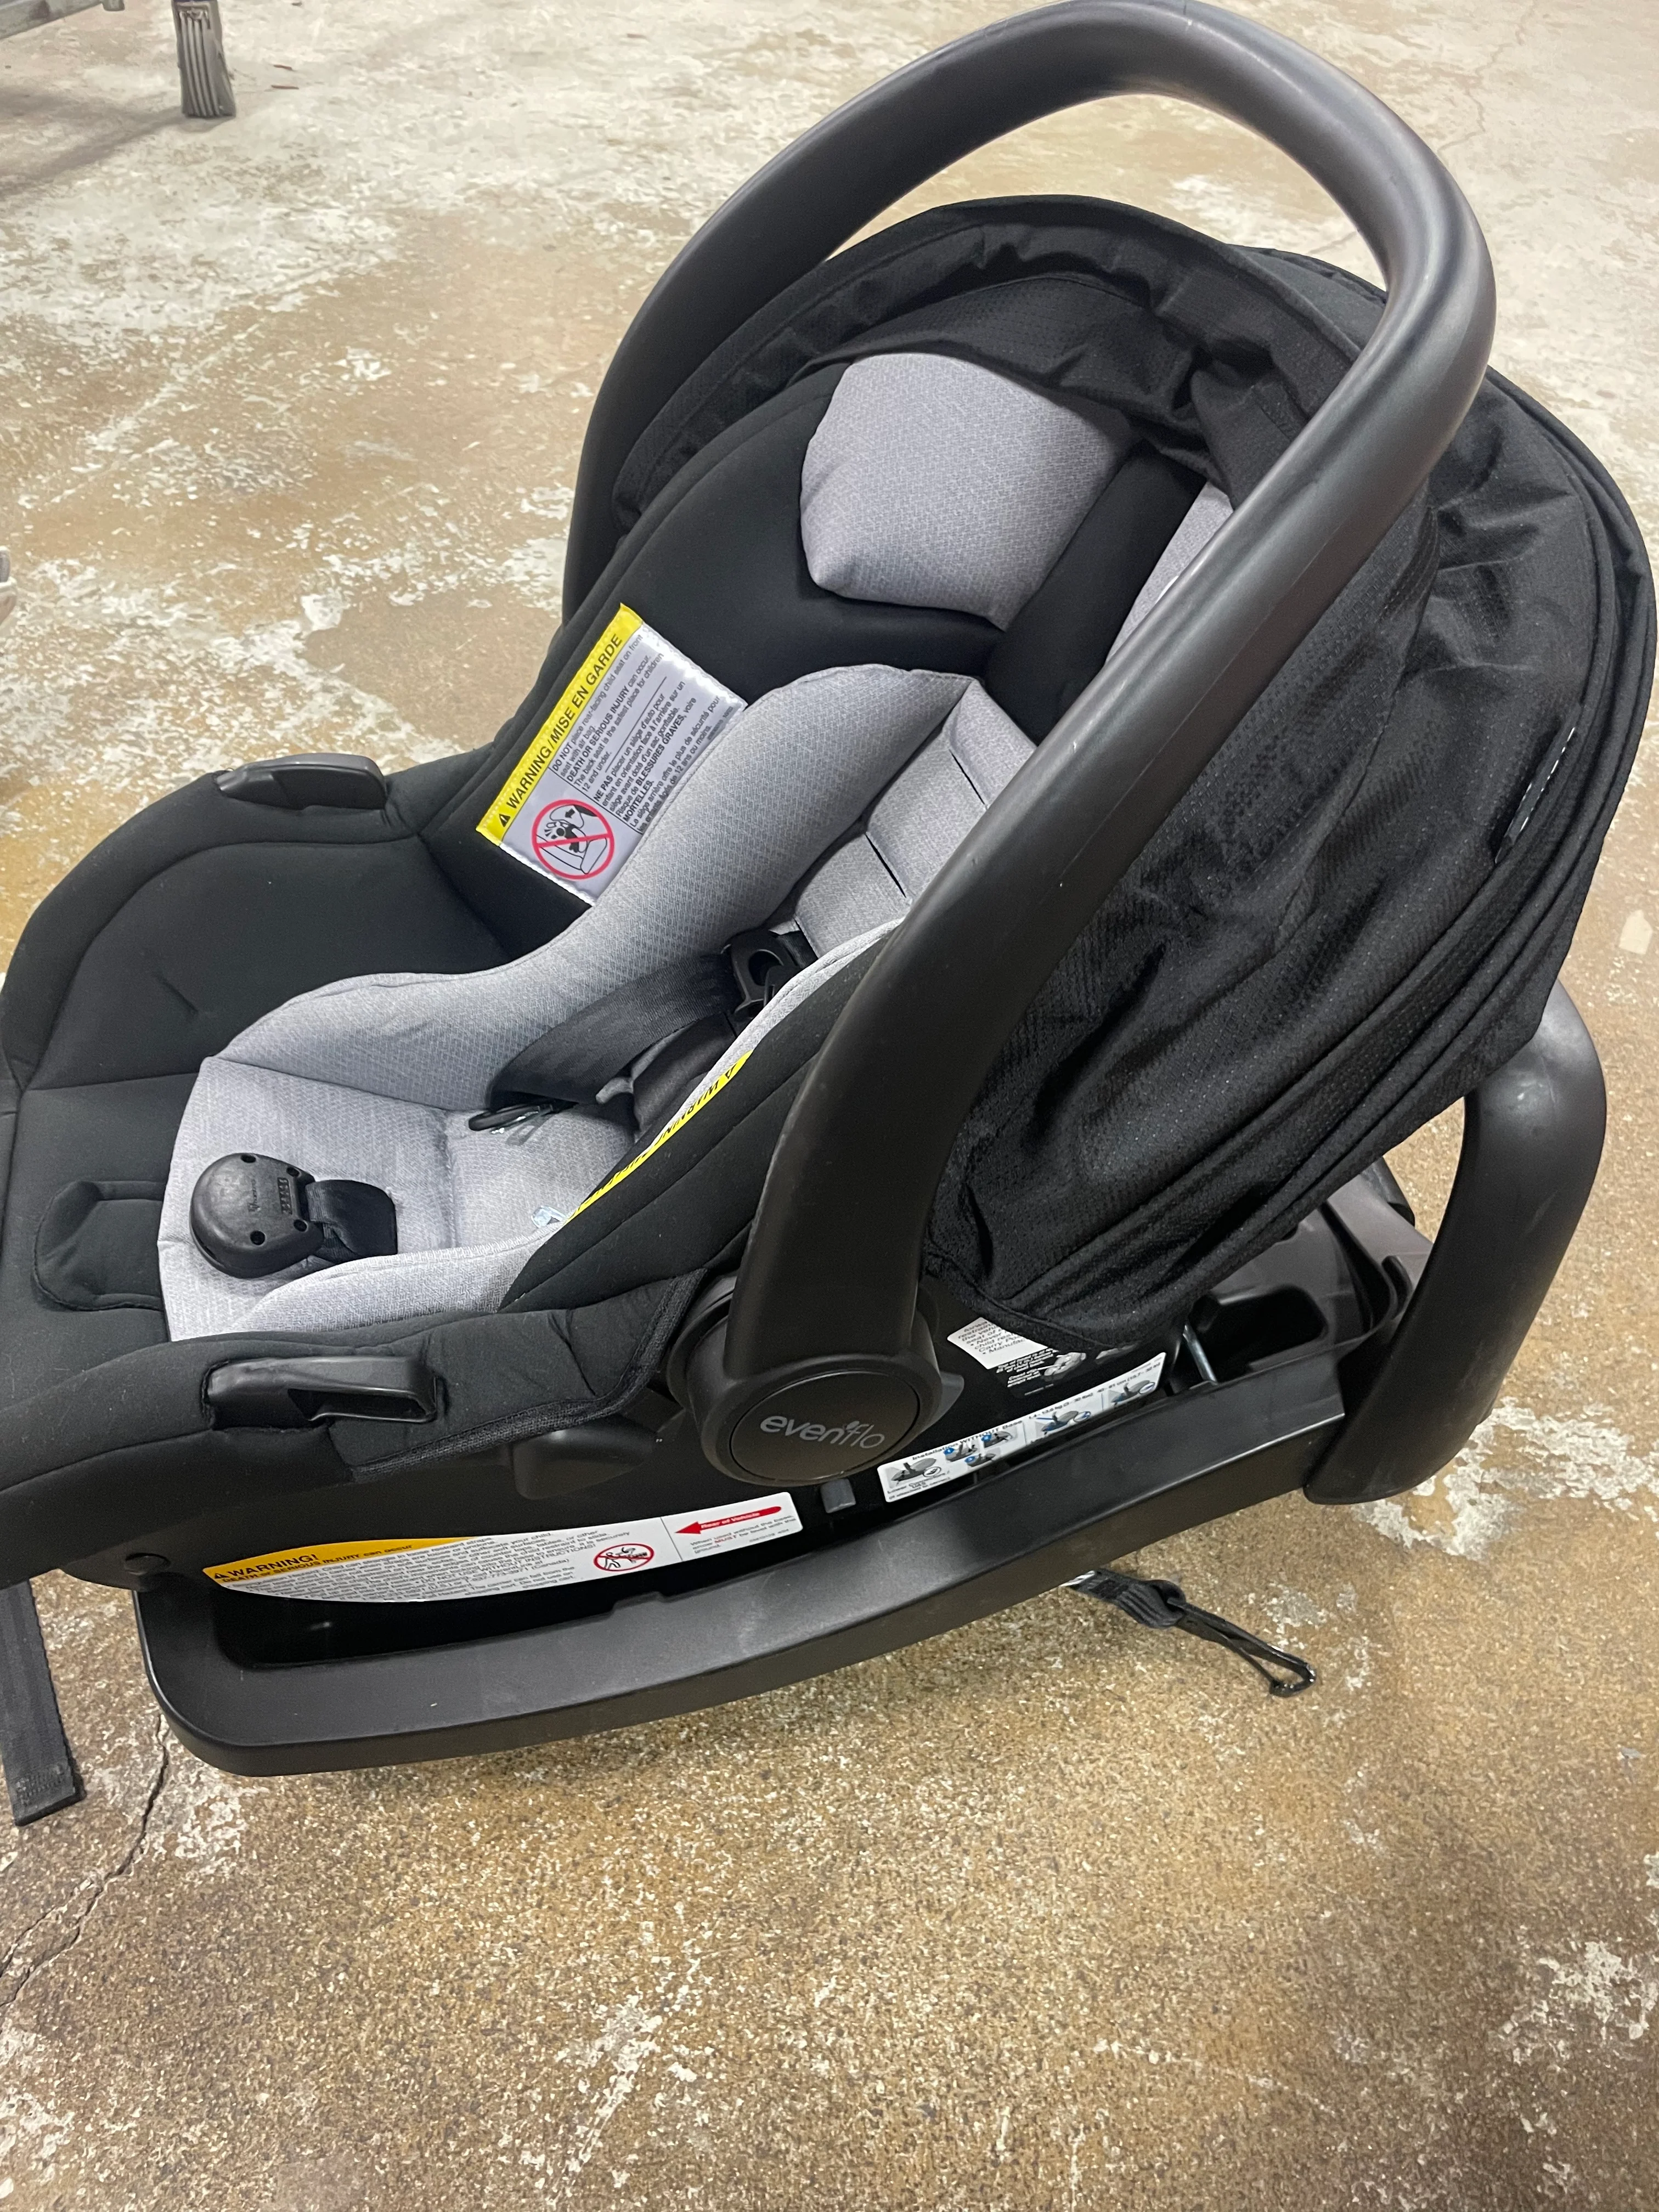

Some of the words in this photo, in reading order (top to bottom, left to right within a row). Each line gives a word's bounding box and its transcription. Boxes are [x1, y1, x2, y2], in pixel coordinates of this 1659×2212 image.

[572, 685, 589, 709] EN
[586, 634, 622, 685] GARDE
[566, 757, 585, 782] DEATH
[582, 746, 592, 758] OR
[589, 713, 613, 746] SERIOUS
[610, 686, 629, 714] INJURY
[552, 759, 562, 771] DO
[559, 742, 573, 760] NOT
[632, 744, 665, 786] BLESSURES
[662, 714, 687, 744] GRAVES,
[573, 774, 585, 786] The
[675, 765, 684, 774] 12
[582, 782, 590, 792] 12
[594, 789, 603, 802] NE
[600, 775, 613, 791] PAS
[620, 780, 654, 822] MORTELLES.
[760, 1415, 885, 1449] evenflo
[960, 1428, 999, 1447] WITHOUT
[714, 1536, 737, 1544] MUST
[222, 1573, 257, 1582] DEATH
[274, 1561, 320, 1574] SERIOUS
[323, 1554, 359, 1564] INJURY
[228, 1554, 319, 1577] WARNING!
